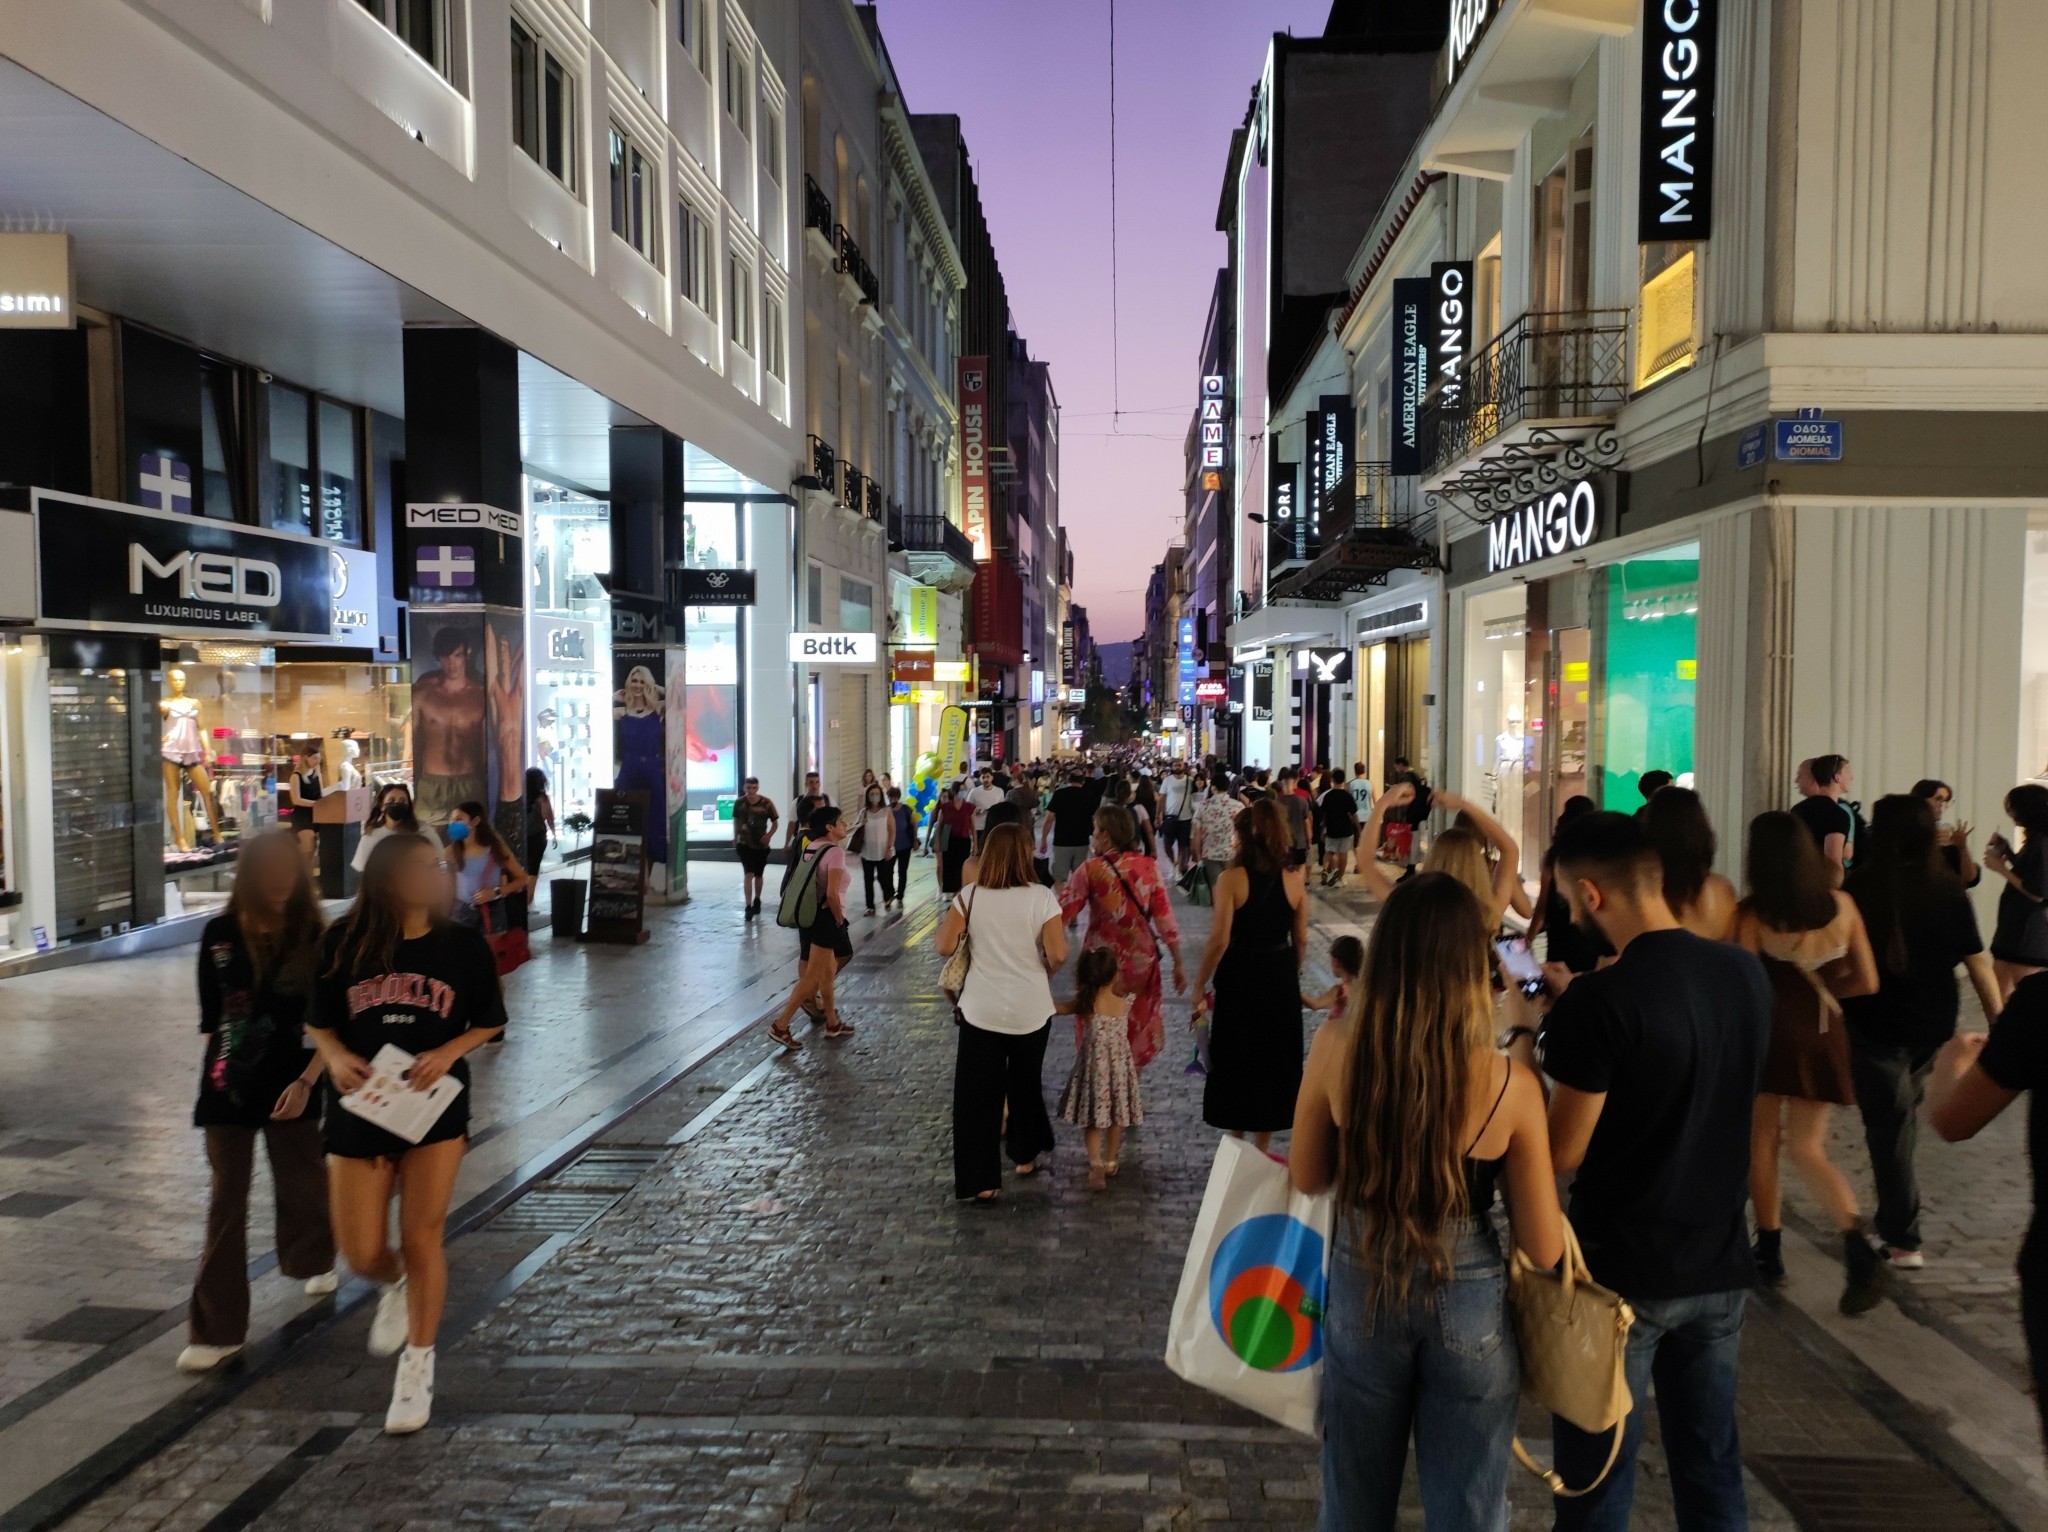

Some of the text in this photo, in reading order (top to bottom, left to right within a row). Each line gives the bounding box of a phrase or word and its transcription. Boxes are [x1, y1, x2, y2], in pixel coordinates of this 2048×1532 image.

[1660, 0, 1699, 223] MANGO
[1403, 304, 1417, 448] AMERICAN EAGLE
[1808, 408, 1814, 419] 1
[1326, 413, 1337, 450] EAGLE
[1793, 424, 1827, 433] ΟΔΟΣ
[966, 404, 984, 476] HOUSE
[1786, 435, 1833, 444] ΔΙΟΜΕΙΑΣ
[1789, 446, 1831, 456] DIOMIAS
[411, 508, 480, 523] MED
[488, 510, 519, 531] MED
[1489, 480, 1595, 573] MANGO
[129, 542, 281, 607] MED
[145, 604, 262, 623] LUXURIOUS LABEL
[803, 637, 857, 655] Bdtk
